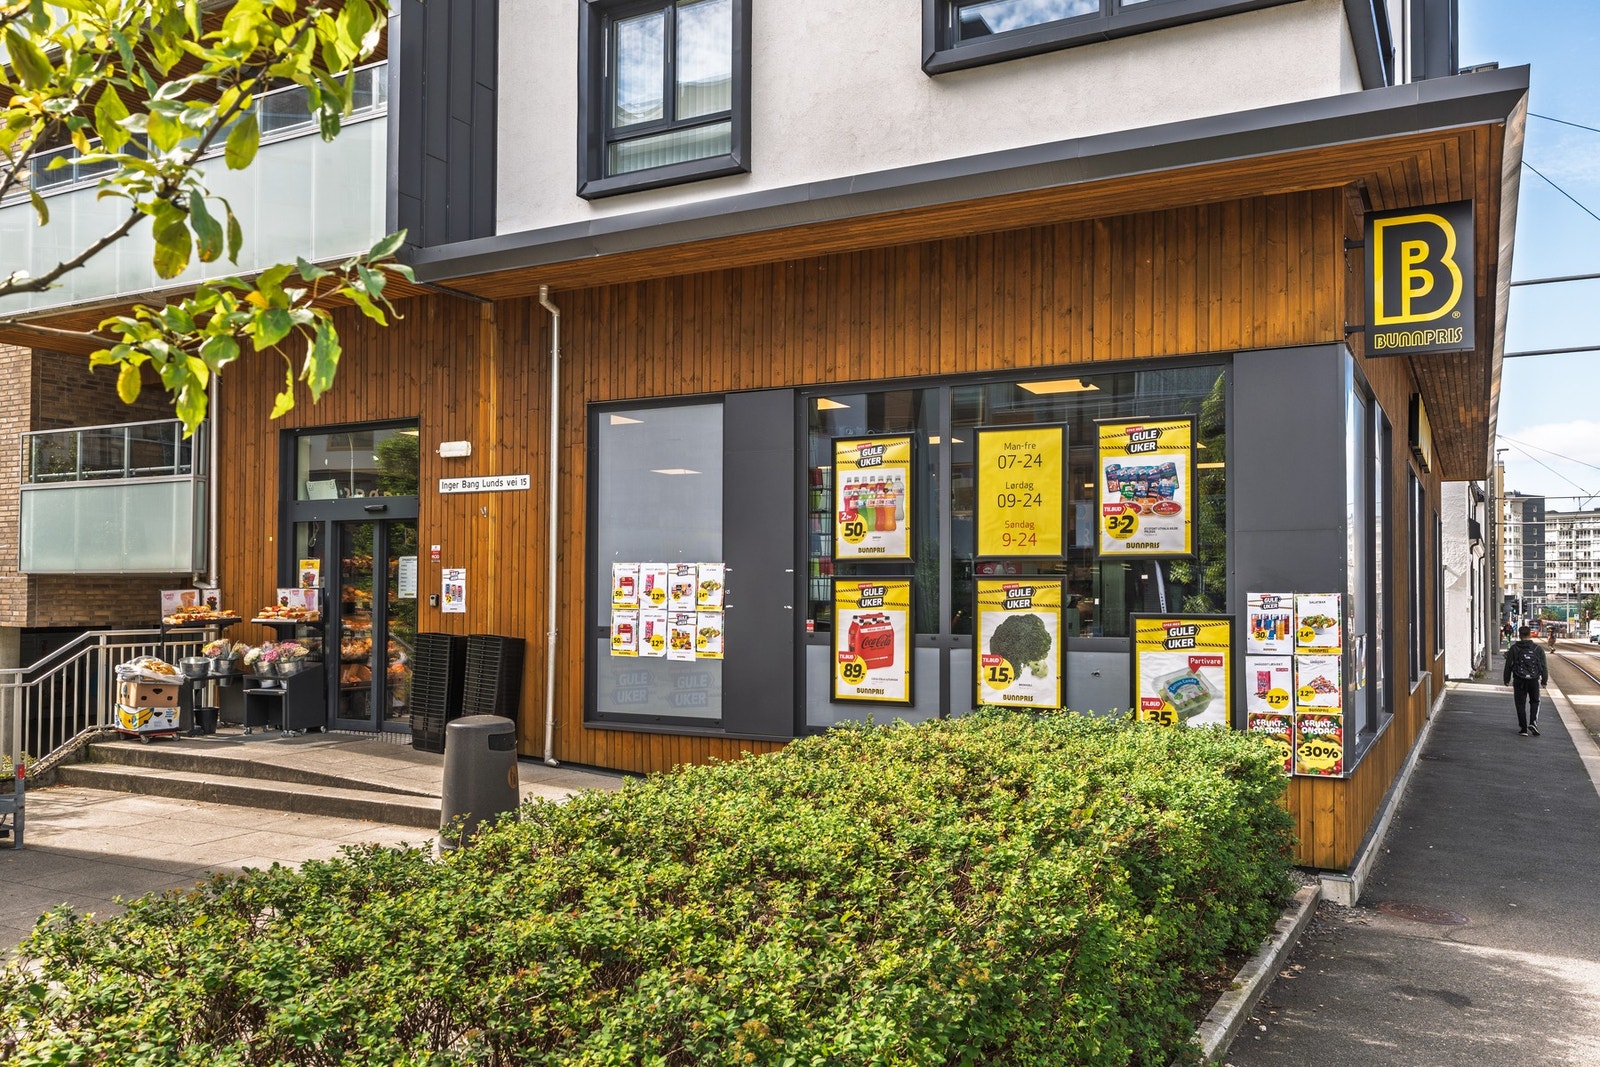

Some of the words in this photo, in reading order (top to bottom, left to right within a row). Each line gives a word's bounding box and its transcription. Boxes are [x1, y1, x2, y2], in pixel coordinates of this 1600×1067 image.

[1374, 327, 1463, 350] BUNNPRIS
[1132, 430, 1157, 441] GULE
[862, 446, 883, 457] GULE
[1004, 442, 1036, 450] Man-fre
[1130, 442, 1156, 453] UKER
[860, 456, 882, 467] UKER
[998, 454, 1042, 470] 07-24
[442, 482, 459, 491] Inger
[462, 480, 480, 490] Bang
[482, 479, 504, 487] Lunds
[506, 478, 518, 486] vei
[1006, 481, 1034, 491] Lørdag
[997, 493, 1042, 508] 09-24
[1004, 520, 1035, 530] Søndag
[1002, 532, 1037, 547] 9-24
[863, 587, 884, 596] GULE
[1008, 588, 1032, 598] GULE
[861, 598, 882, 607] UKER
[1007, 599, 1030, 609] UKER
[1169, 626, 1195, 636] GULE
[1168, 638, 1194, 649] UKER
[617, 690, 648, 703] UKER
[675, 694, 706, 706] UKER
[1300, 746, 1338, 758] -30%
